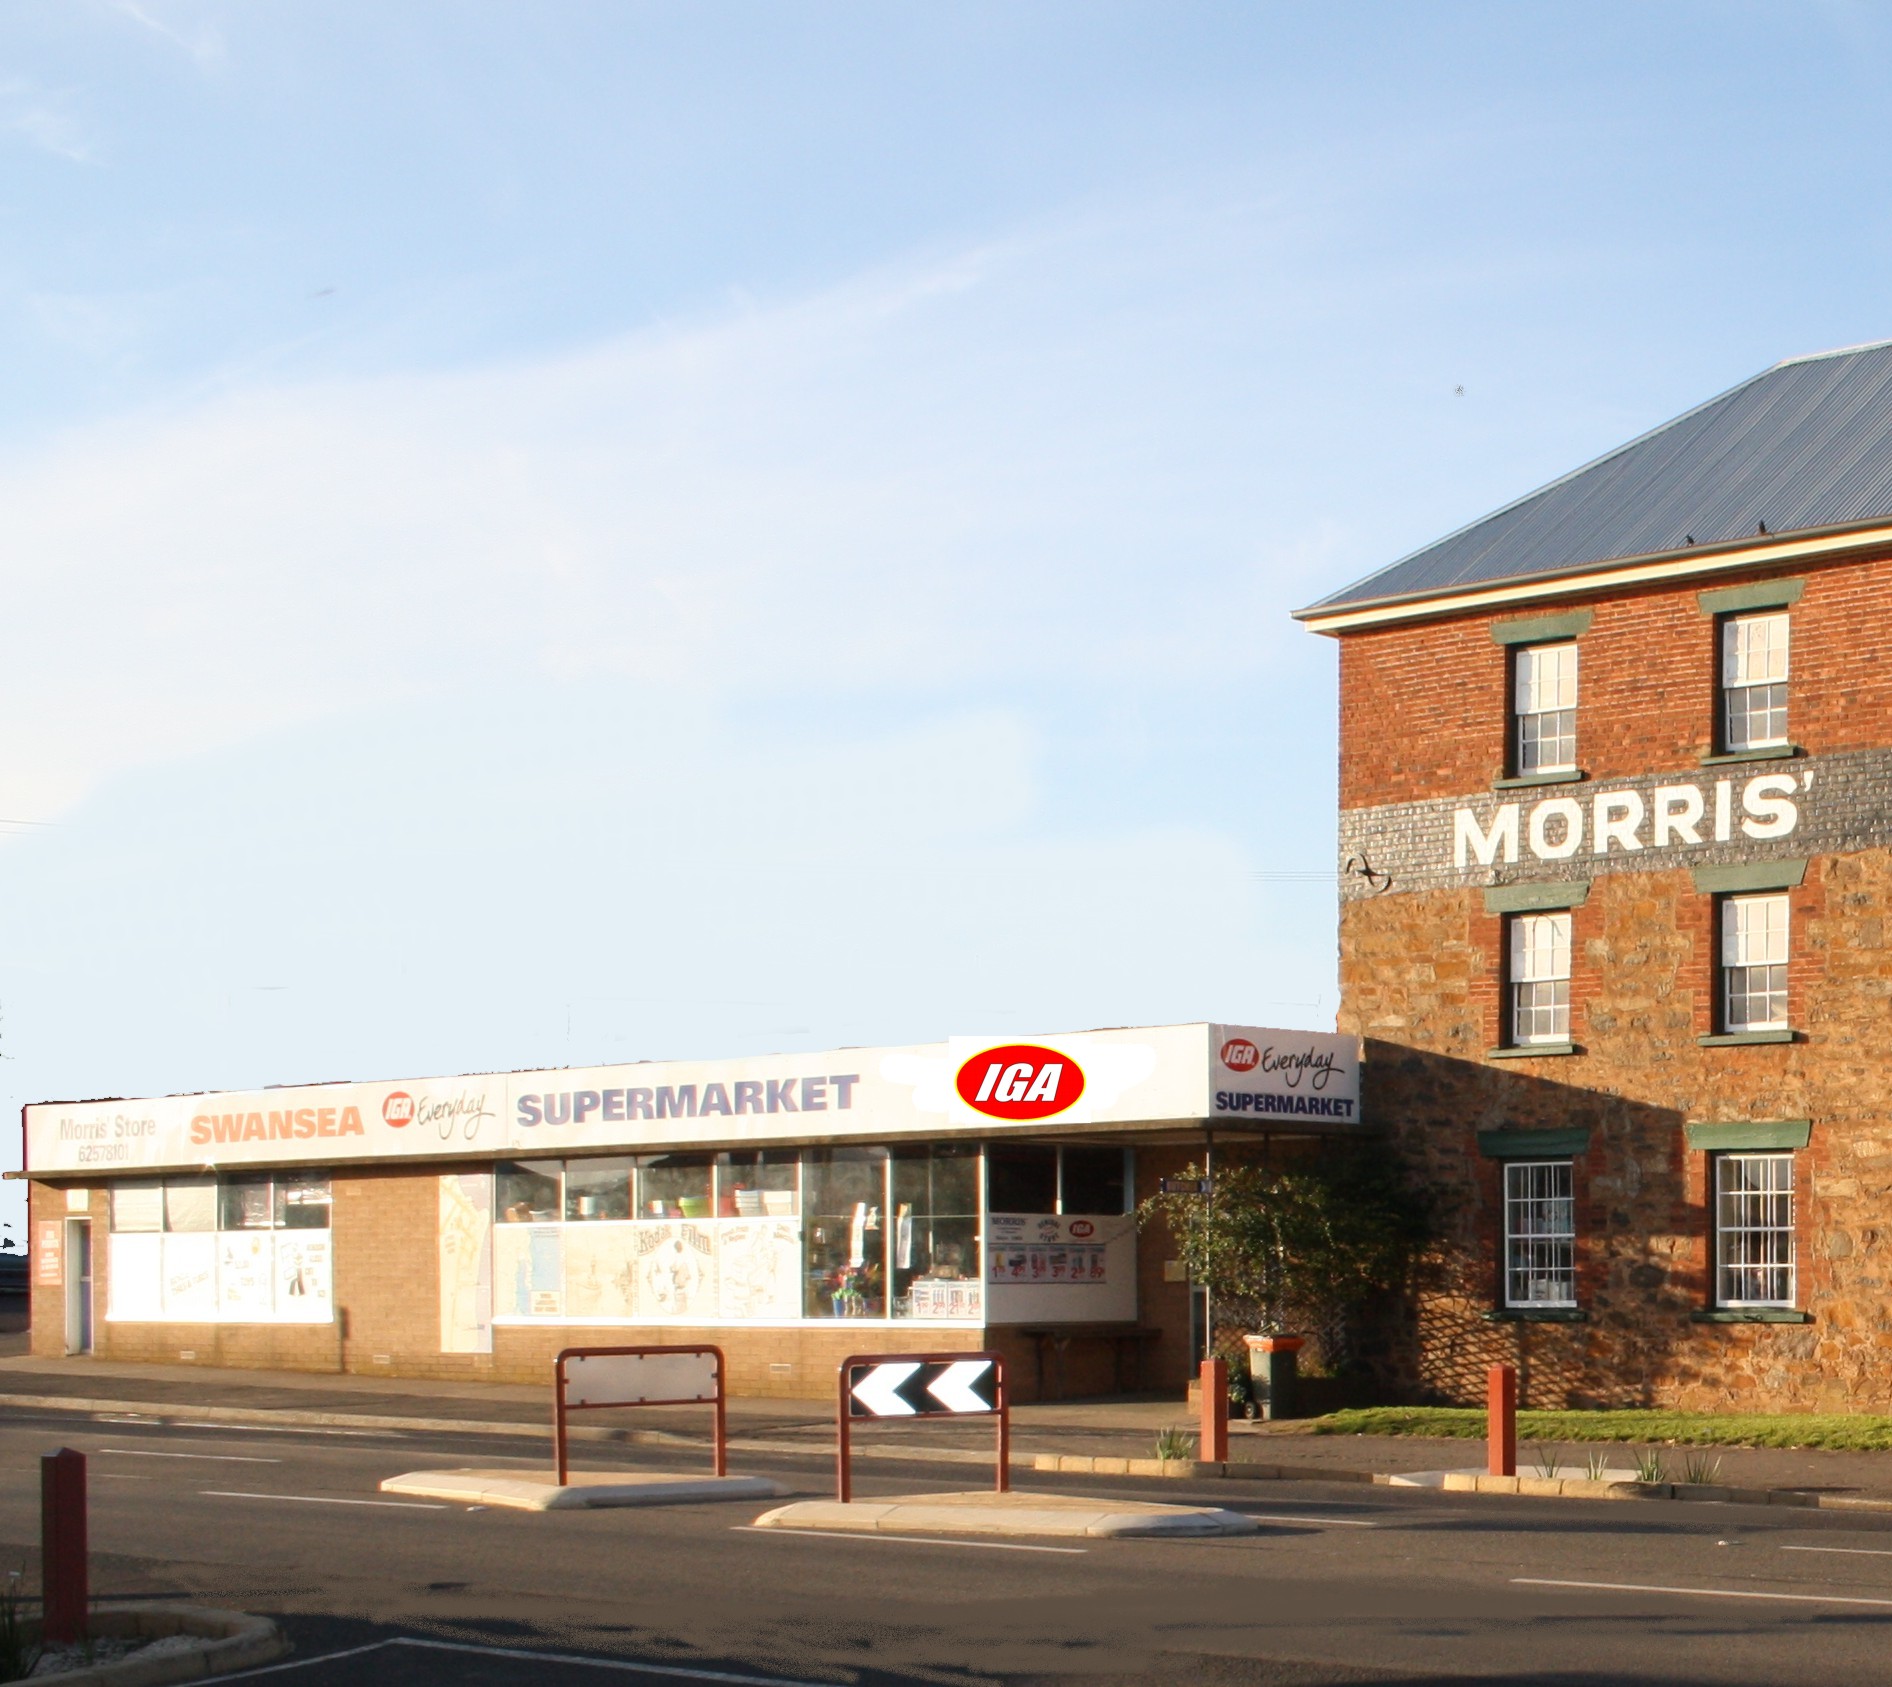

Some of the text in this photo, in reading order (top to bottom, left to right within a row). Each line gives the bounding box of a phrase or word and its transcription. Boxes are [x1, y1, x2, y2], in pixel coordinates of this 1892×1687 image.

[1453, 770, 1814, 868] MORRIS'
[974, 1062, 1063, 1102] IGA
[1261, 1046, 1345, 1090] Everyday
[417, 1089, 496, 1140] Everyday
[516, 1074, 860, 1127] SUPERMARKET
[1215, 1091, 1354, 1117] SUPERMARKET
[114, 1114, 156, 1138] Store
[190, 1105, 365, 1145] SWANSEA
